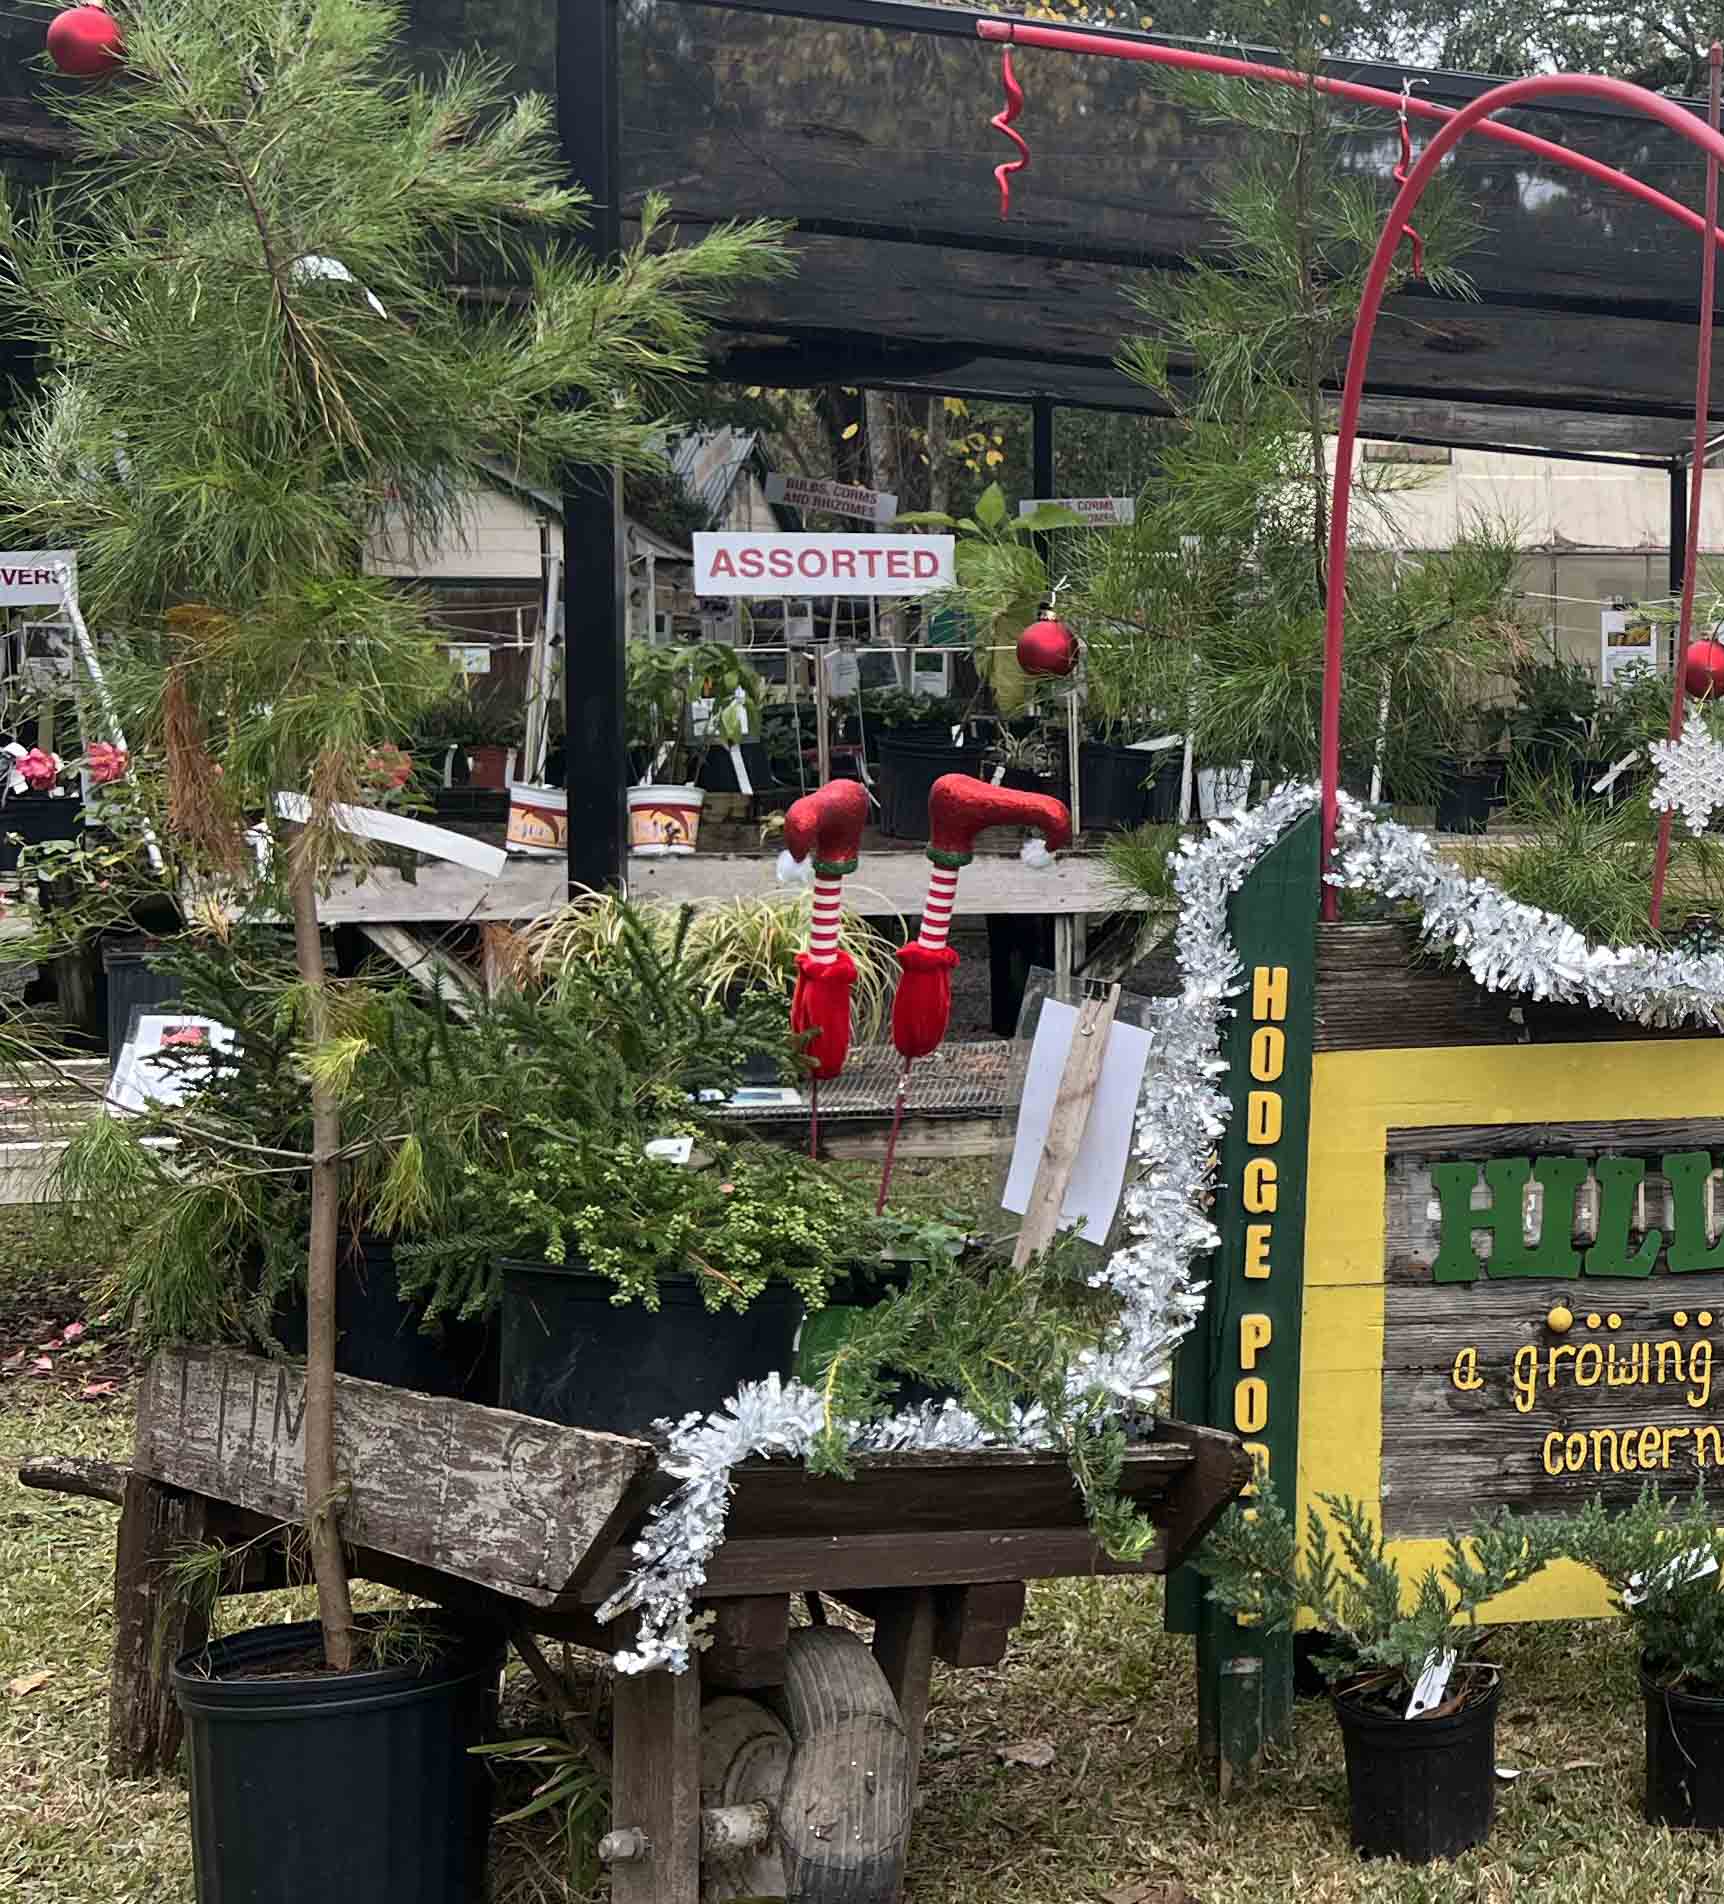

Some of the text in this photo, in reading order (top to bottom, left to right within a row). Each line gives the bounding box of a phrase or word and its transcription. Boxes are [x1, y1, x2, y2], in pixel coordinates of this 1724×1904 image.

[709, 548, 940, 579] ASSORTED
[1241, 966, 1289, 1281] HODGE
[1452, 1339, 1713, 1413] a growing
